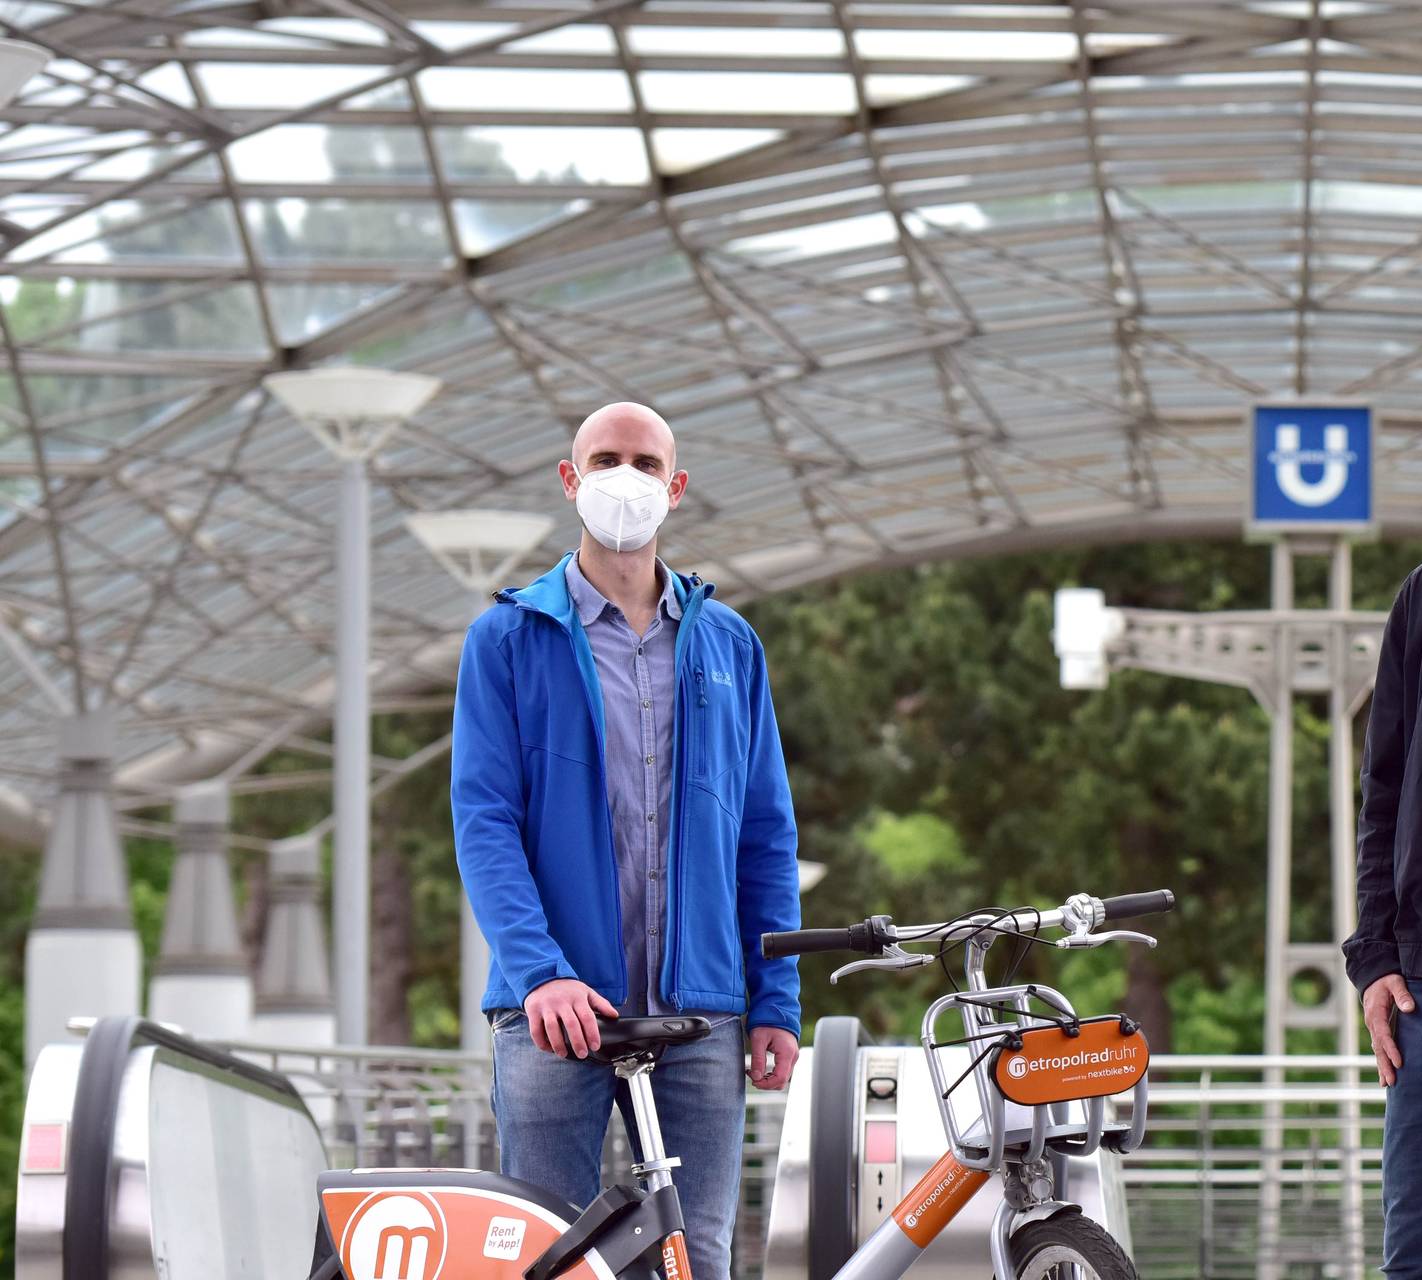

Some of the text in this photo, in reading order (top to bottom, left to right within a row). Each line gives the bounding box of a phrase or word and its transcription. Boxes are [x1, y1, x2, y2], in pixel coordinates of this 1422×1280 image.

[1275, 423, 1349, 508] U
[1007, 1040, 1137, 1080] metropolradruhr
[1087, 1067, 1123, 1079] nextbike
[490, 1226, 516, 1237] Rent
[488, 1238, 521, 1251] by App!
[662, 1246, 681, 1280] 501
